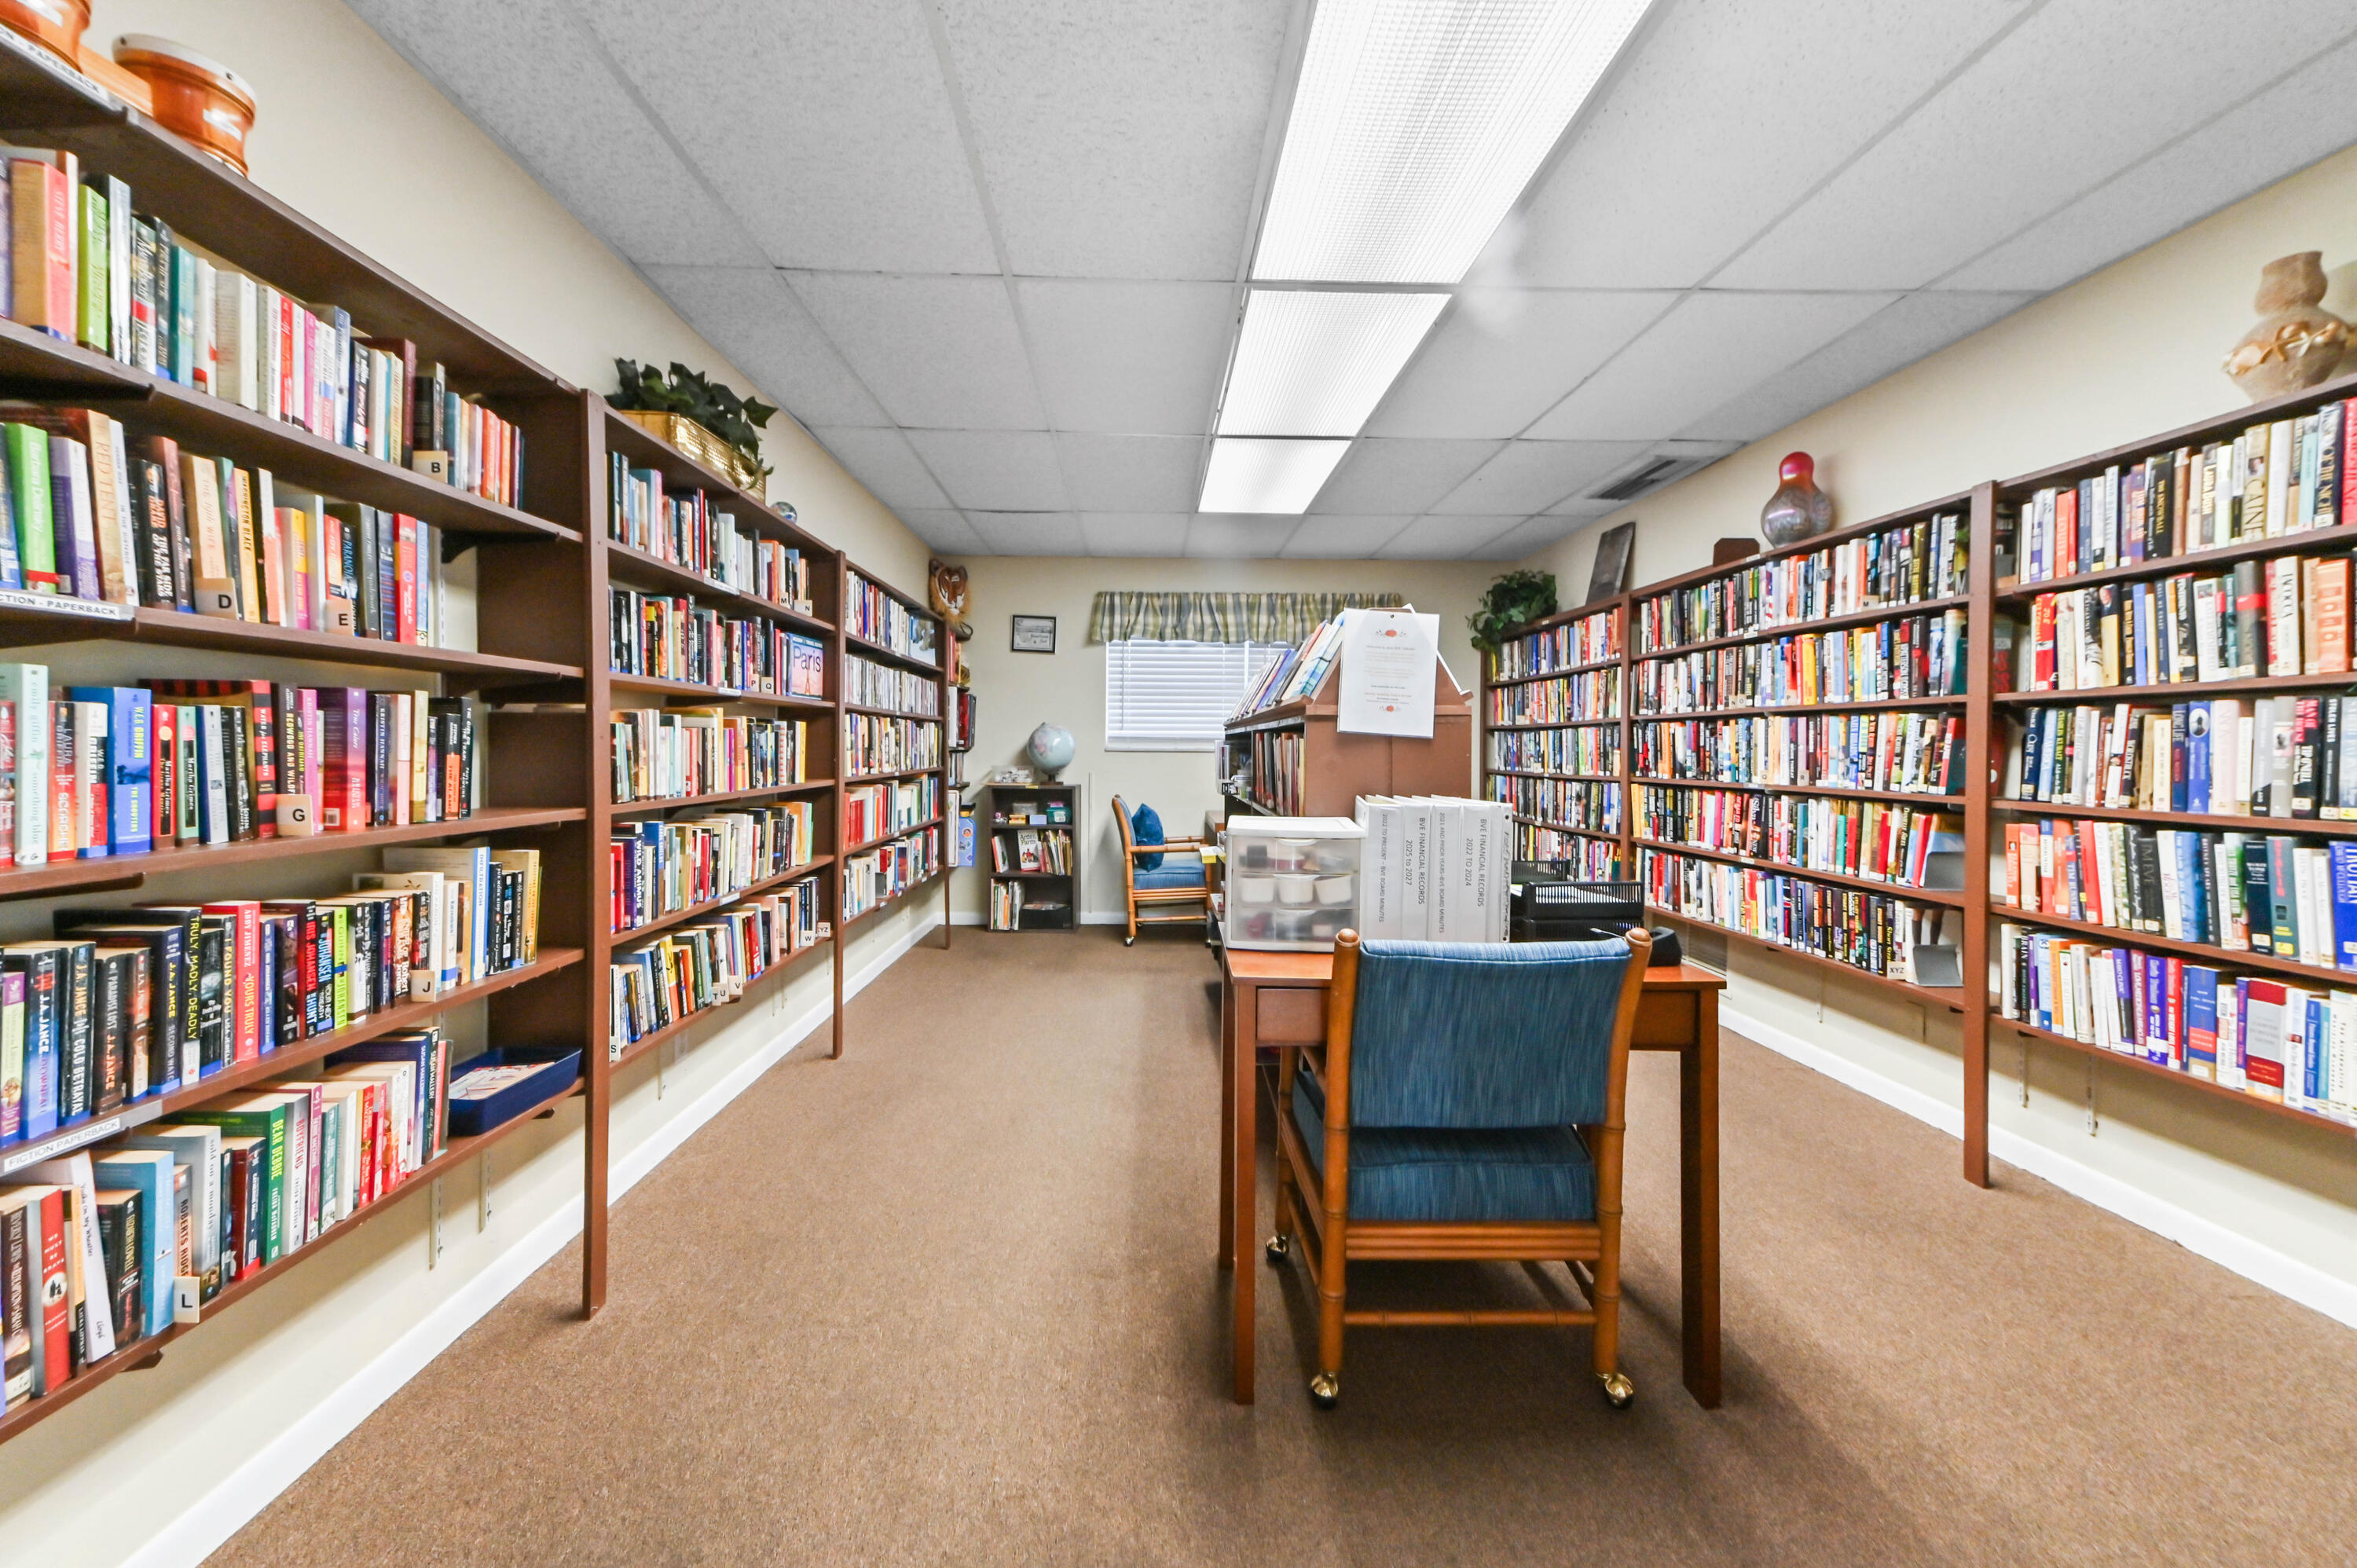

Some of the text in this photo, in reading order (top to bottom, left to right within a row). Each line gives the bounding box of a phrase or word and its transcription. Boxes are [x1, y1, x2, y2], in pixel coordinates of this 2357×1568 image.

[30, 441, 44, 485] Barbara
[431, 462, 442, 473] B
[155, 499, 167, 529] DAVID
[152, 533, 164, 596] OF THE STARS
[159, 535, 173, 597] THE FAR SIDE
[343, 540, 354, 579] PARANOIA
[47, 599, 117, 617] PAPERBACK
[218, 595, 232, 609] D
[339, 614, 349, 626] E
[794, 646, 821, 673] Paris
[28, 682, 41, 742] emily giffin
[2172, 710, 2186, 728] LONG
[2326, 699, 2337, 743] STOLEN LIVES
[64, 728, 73, 765] LAURA
[134, 727, 145, 759] GRIFFIN
[286, 713, 295, 749] REDWOOD
[287, 752, 295, 768] AND
[2123, 739, 2135, 780] WORDSTRUCK
[30, 771, 43, 844] something blue
[293, 809, 305, 822] G
[1466, 858, 1472, 866] TO
[1479, 834, 1487, 872] FINANCIAL
[2143, 864, 2154, 884] EVE
[2069, 881, 2080, 916] RUSSERT
[189, 916, 200, 953] TRULY,
[224, 947, 233, 986] FOUND
[306, 921, 317, 991] IRIS JOHANSEN
[318, 939, 333, 983] JOHANSEN
[75, 964, 87, 1017] J.A. JANCE
[107, 975, 117, 1029] PARADISE LOST
[224, 991, 233, 1013] YOU
[244, 976, 254, 1034] YOURS TRULY
[422, 981, 431, 993] J
[38, 1017, 49, 1053] JANCE
[188, 998, 198, 1039] DEADLY
[610, 1044, 617, 1053] S
[72, 1039, 84, 1116] COLD BETRAYAL
[9, 1121, 119, 1167] FICTION PAPERBACK
[271, 1119, 284, 1181] DEAR DEBBIE
[295, 1119, 305, 1169] BOYFRIEND
[209, 1163, 215, 1177] on
[207, 1192, 216, 1230] monday
[181, 1294, 193, 1309] L
